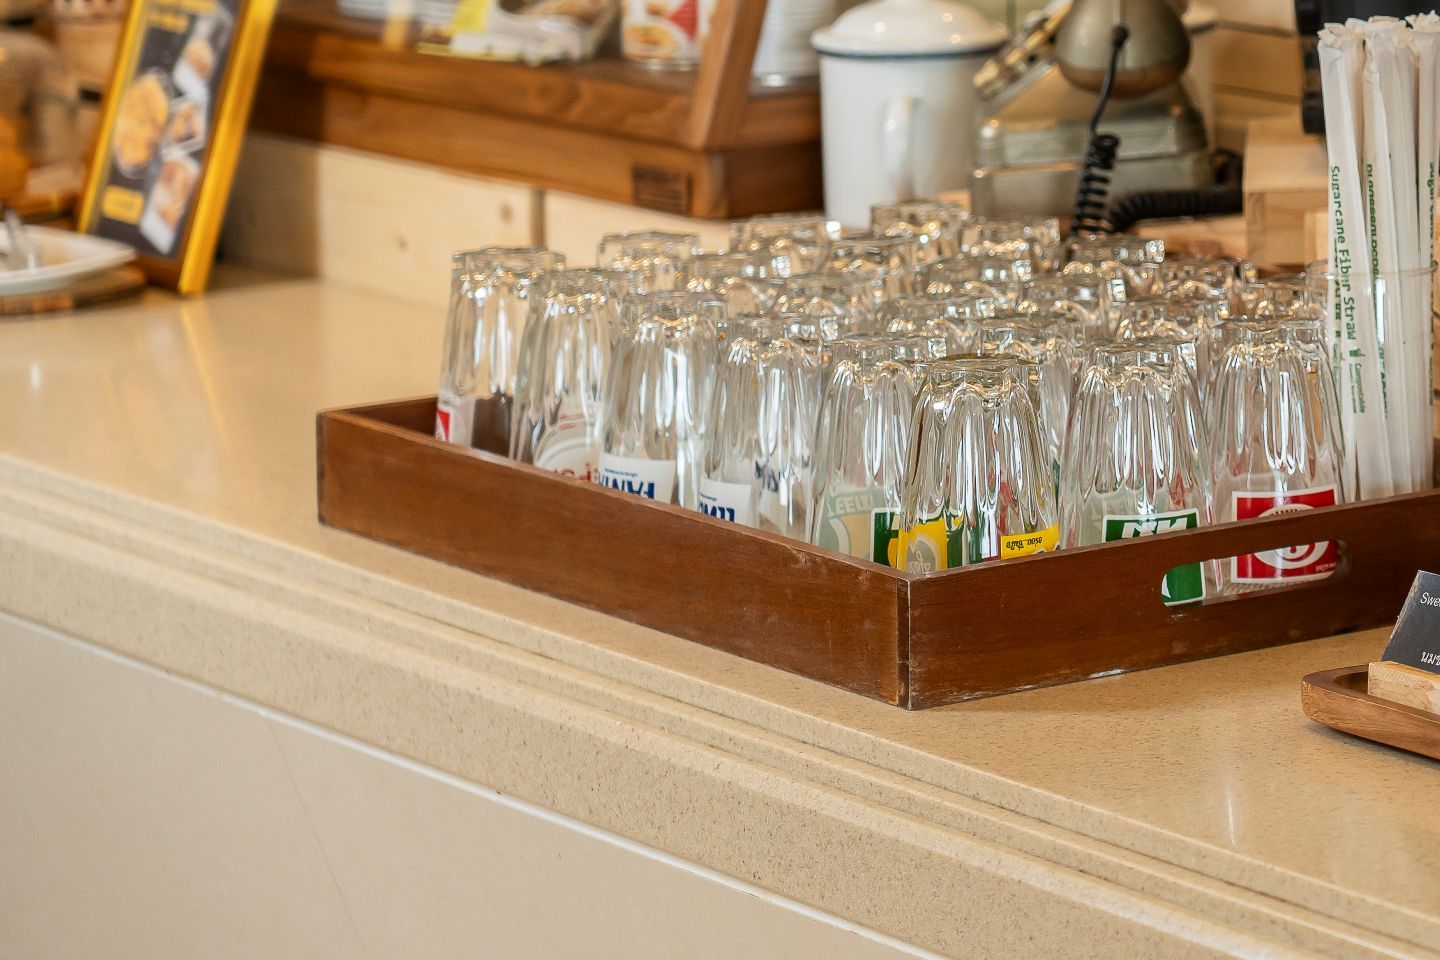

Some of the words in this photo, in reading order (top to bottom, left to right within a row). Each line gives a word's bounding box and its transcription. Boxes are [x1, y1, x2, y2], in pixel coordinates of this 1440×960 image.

[1331, 166, 1346, 244] Sugarcane
[1339, 249, 1352, 291] Fiber
[1344, 297, 1357, 340] Straw
